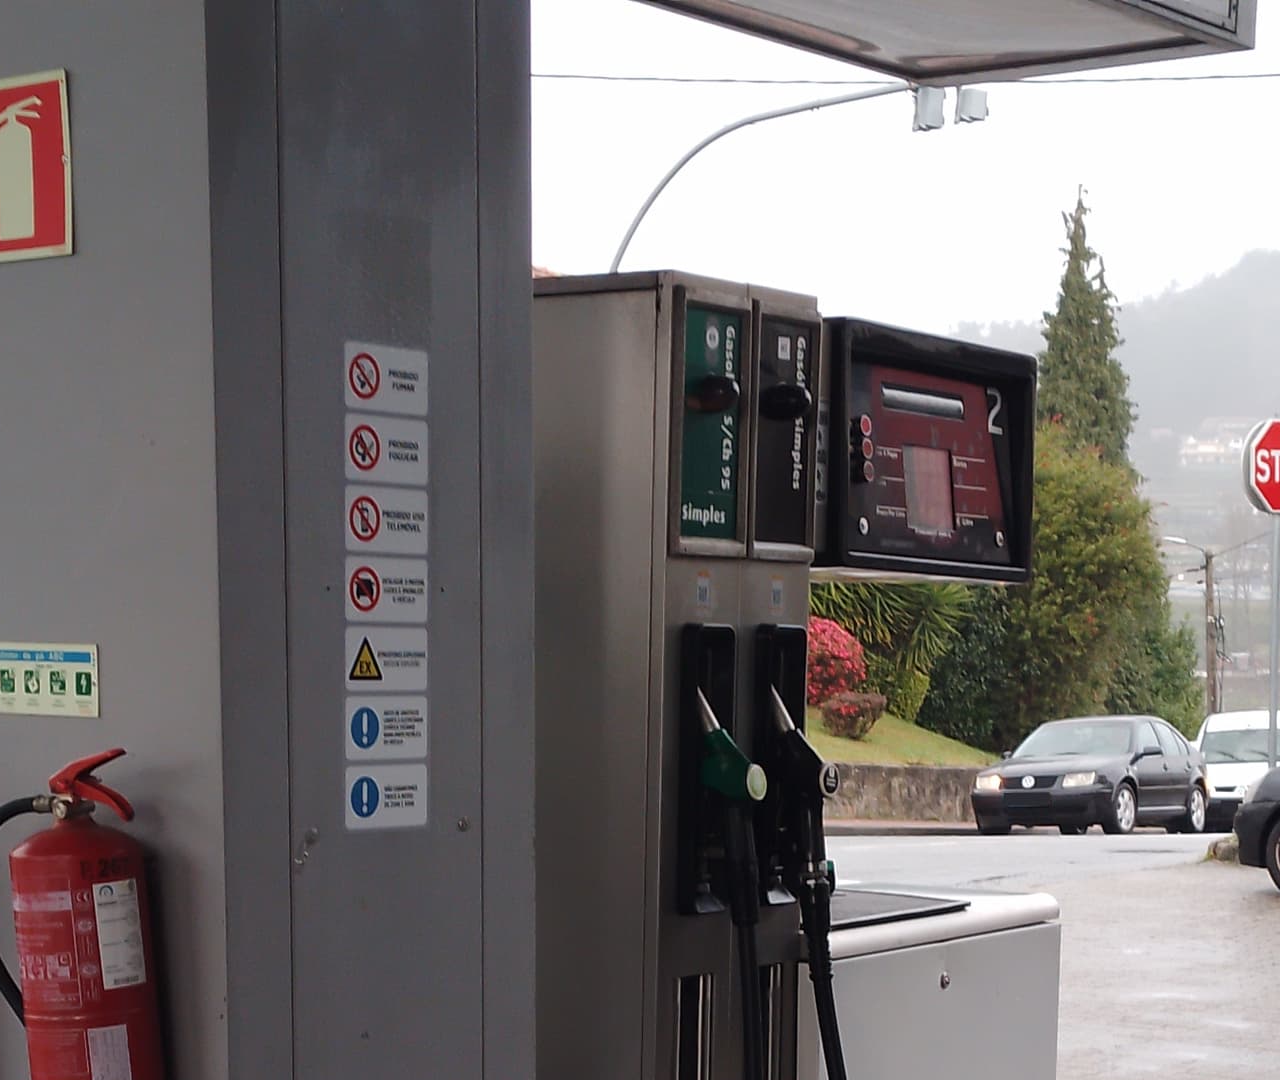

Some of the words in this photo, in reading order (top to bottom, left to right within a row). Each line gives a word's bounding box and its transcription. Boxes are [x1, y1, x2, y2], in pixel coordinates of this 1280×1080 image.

[986, 386, 1003, 436] 2
[721, 467, 731, 490] 95
[359, 660, 372, 674] EX
